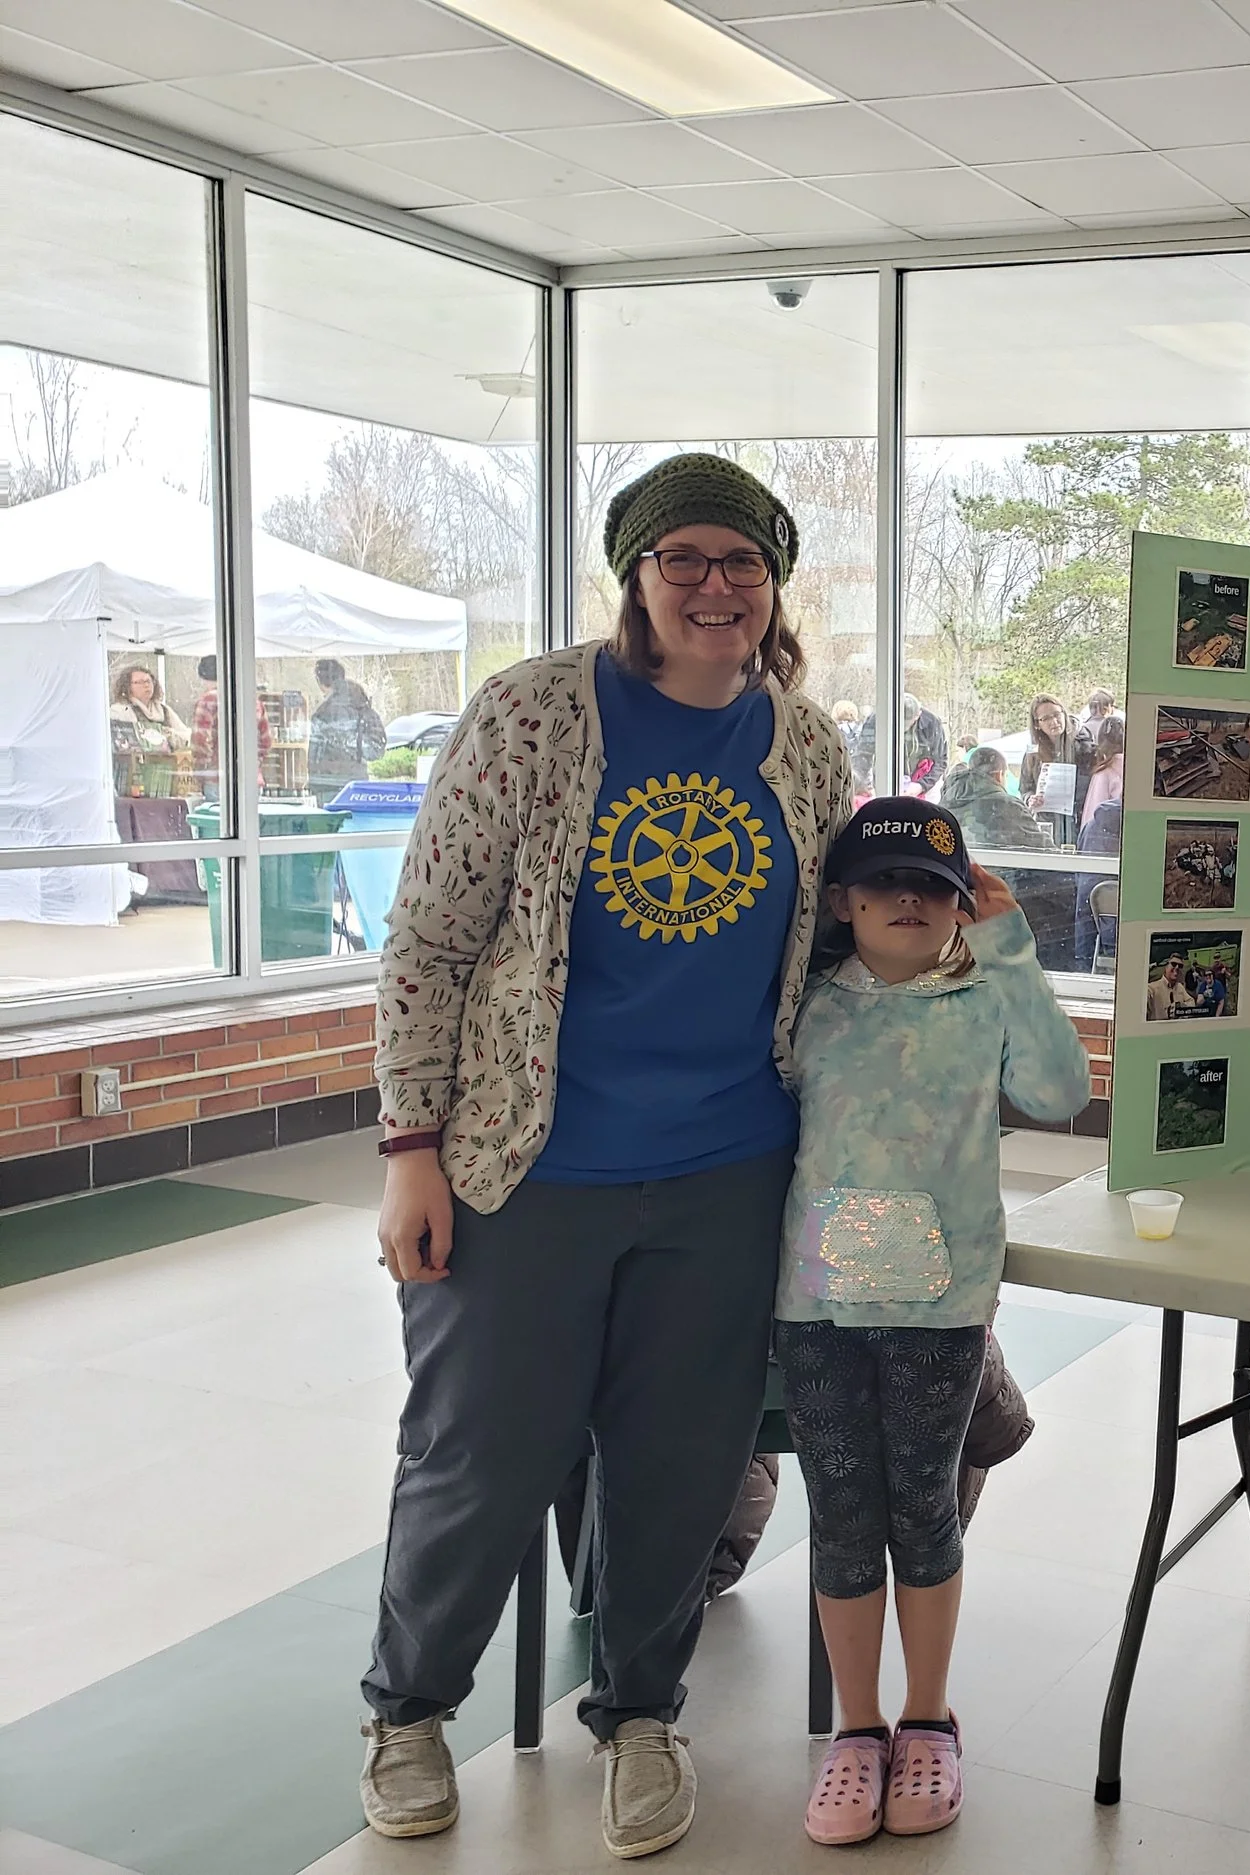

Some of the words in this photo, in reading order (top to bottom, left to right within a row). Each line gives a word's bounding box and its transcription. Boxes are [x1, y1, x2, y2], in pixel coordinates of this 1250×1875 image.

[1214, 583, 1240, 596] before
[656, 790, 723, 814] ROTARY
[862, 820, 922, 839] Rotary
[616, 876, 742, 925] INTERNATIONAL
[1200, 1070, 1223, 1084] after
